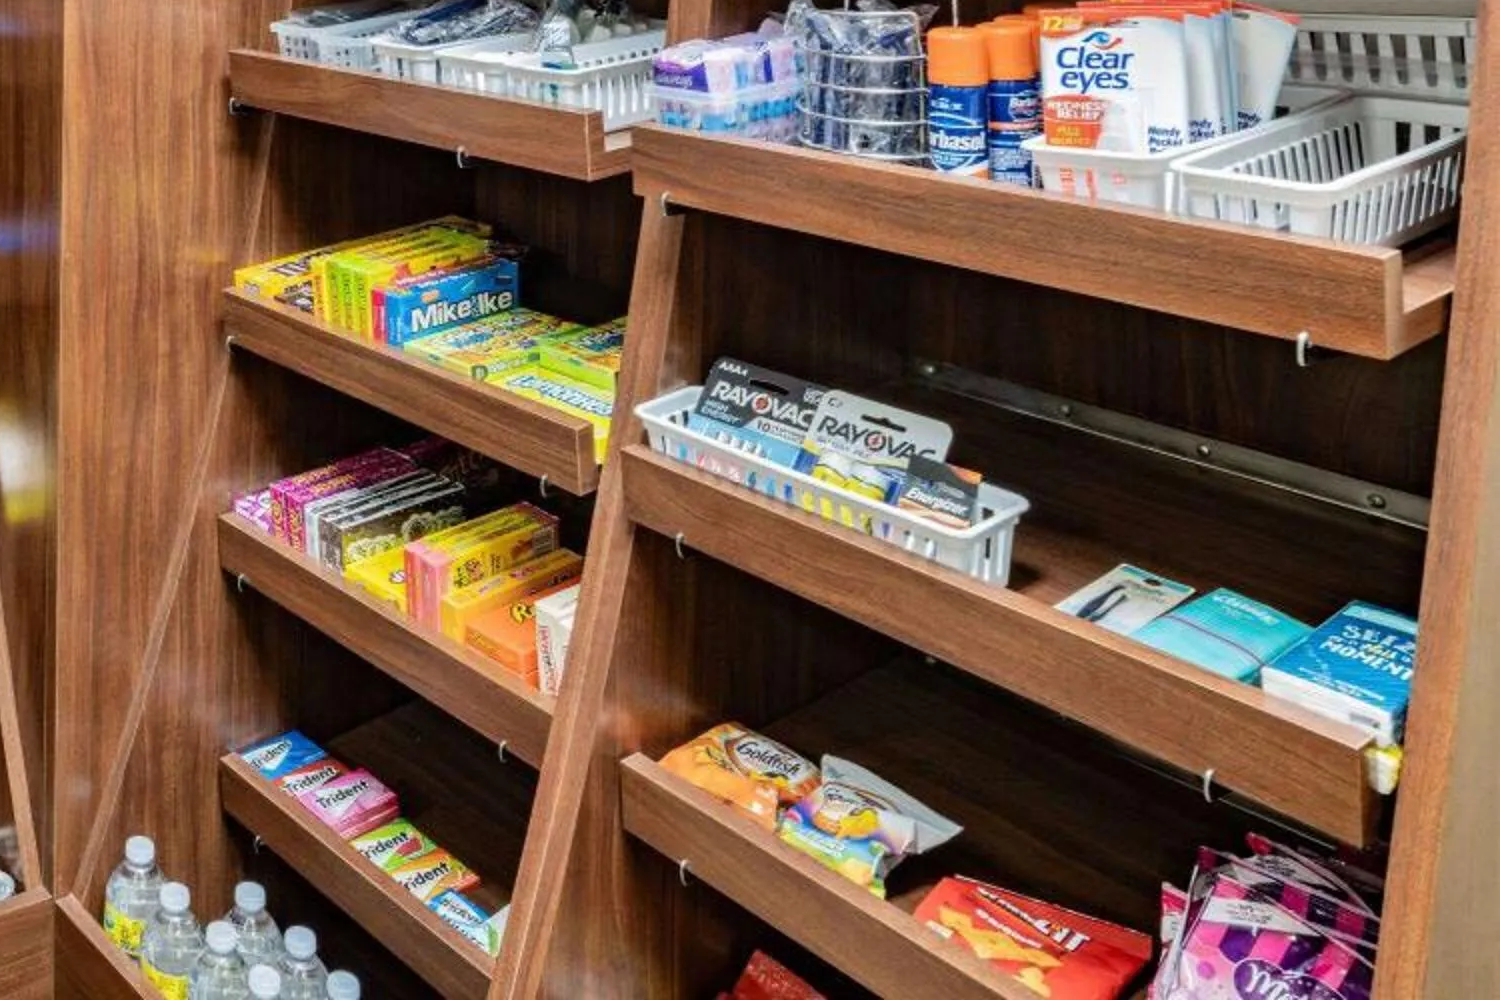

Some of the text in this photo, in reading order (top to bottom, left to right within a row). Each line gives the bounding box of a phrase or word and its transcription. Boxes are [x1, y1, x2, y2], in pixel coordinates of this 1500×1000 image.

[1043, 17, 1062, 31] 12
[1056, 46, 1136, 70] Clear
[1060, 69, 1130, 95] eyes
[411, 303, 471, 333] Mike
[477, 289, 514, 319] Ike
[711, 381, 815, 434] RAYOVAC
[816, 415, 937, 459] RAYOVAC
[906, 487, 967, 517] Energizer
[1318, 640, 1415, 681] MOMENT
[250, 738, 291, 770] Trident
[735, 740, 802, 776] Goldfish
[283, 765, 336, 793] Trident
[314, 780, 368, 809] Trident
[400, 861, 449, 891] rident
